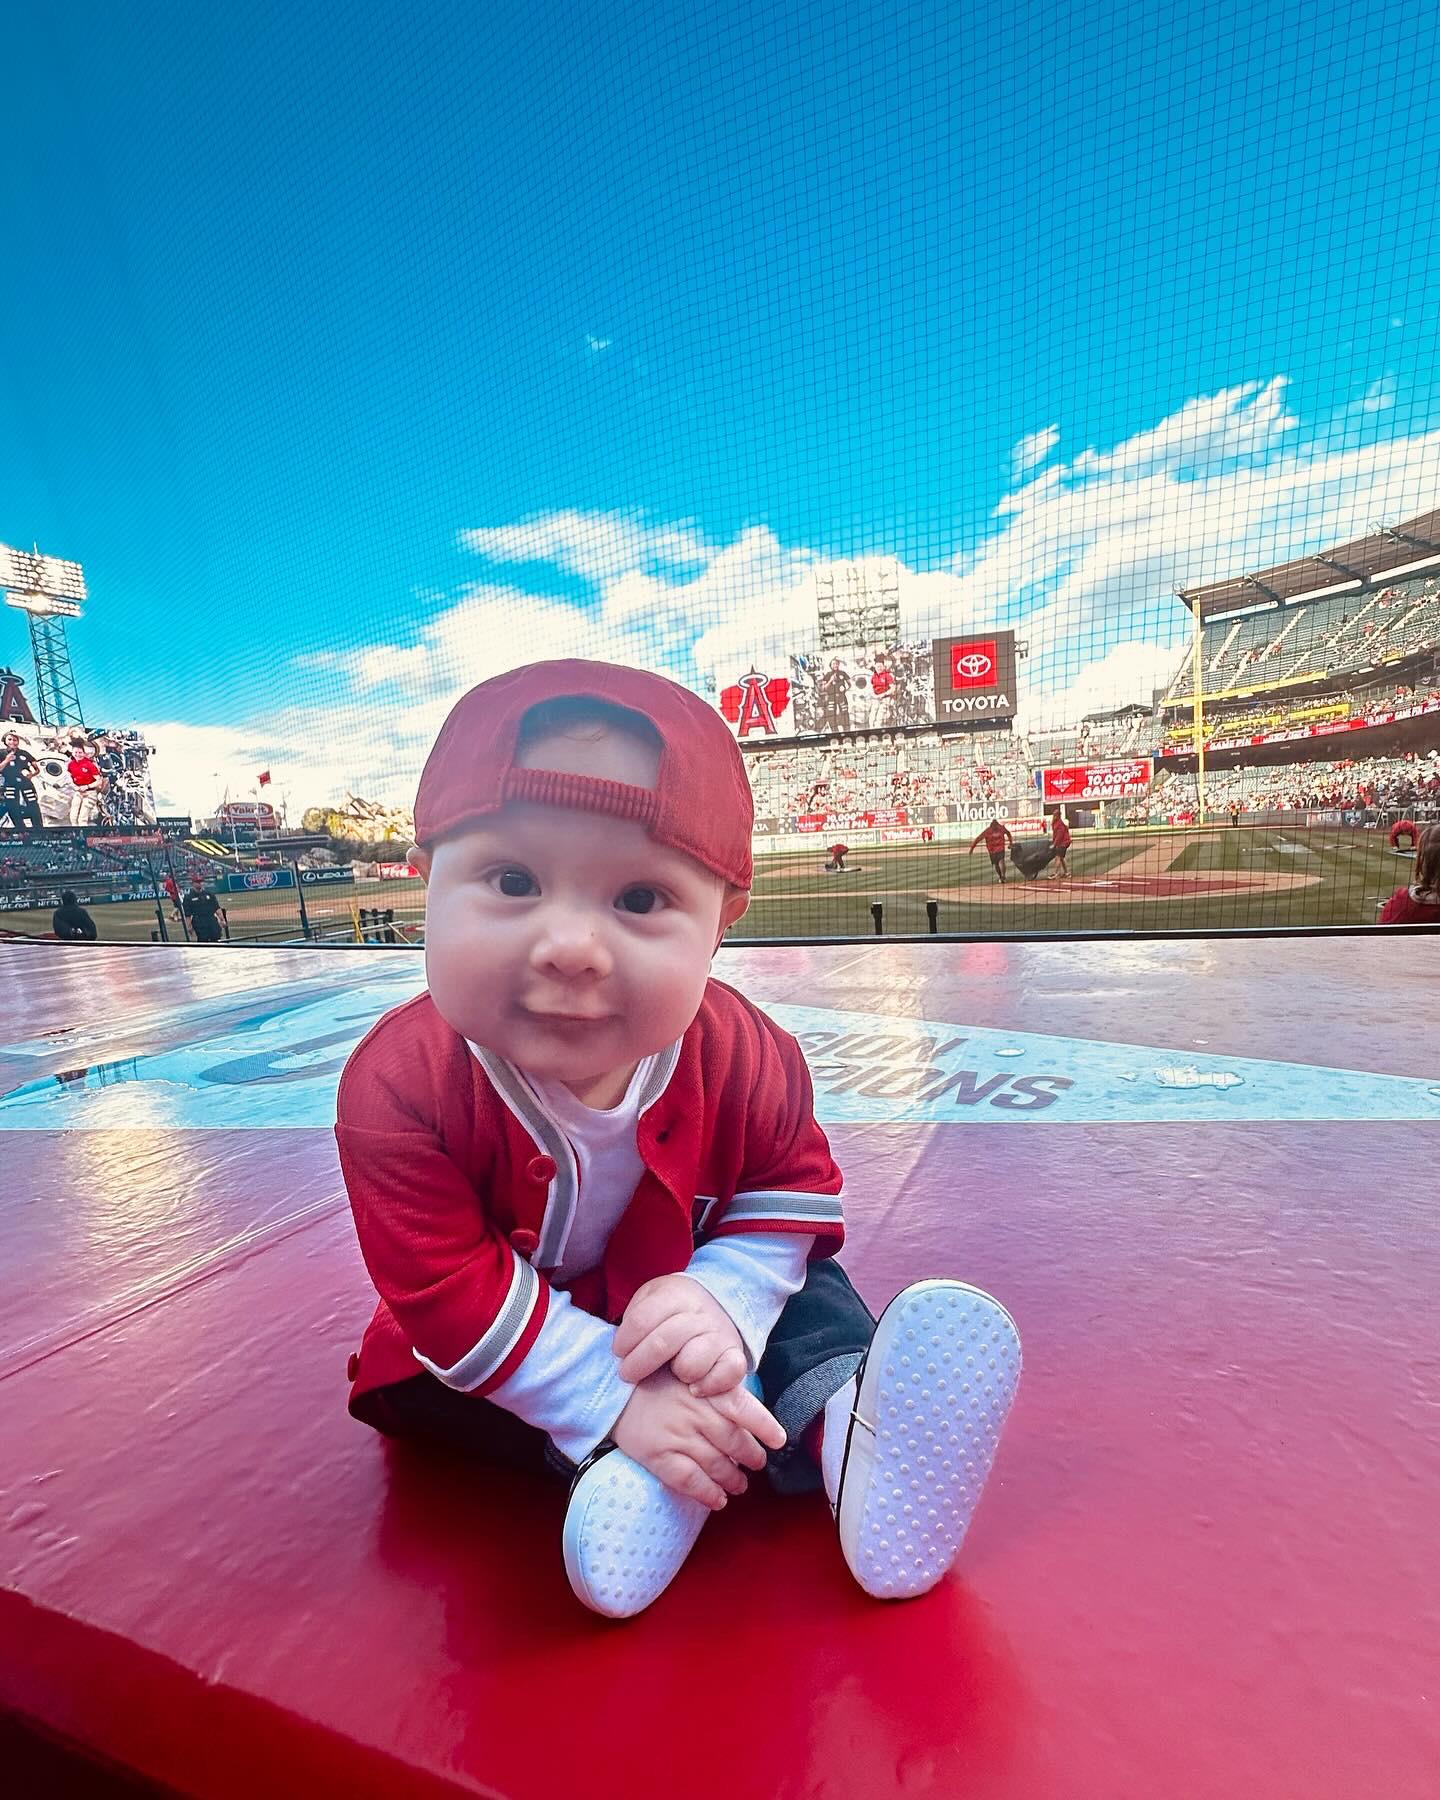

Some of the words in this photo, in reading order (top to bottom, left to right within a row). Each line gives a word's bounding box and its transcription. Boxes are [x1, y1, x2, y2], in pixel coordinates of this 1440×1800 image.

[942, 694, 1010, 713] TOYOTA
[1087, 770, 1137, 787] 10,000TH
[1081, 784, 1122, 798] GAME
[1124, 782, 1148, 794] PIN
[956, 802, 1009, 820] Modelo
[852, 819, 868, 829] PIN
[316, 872, 353, 880] LEXUS
